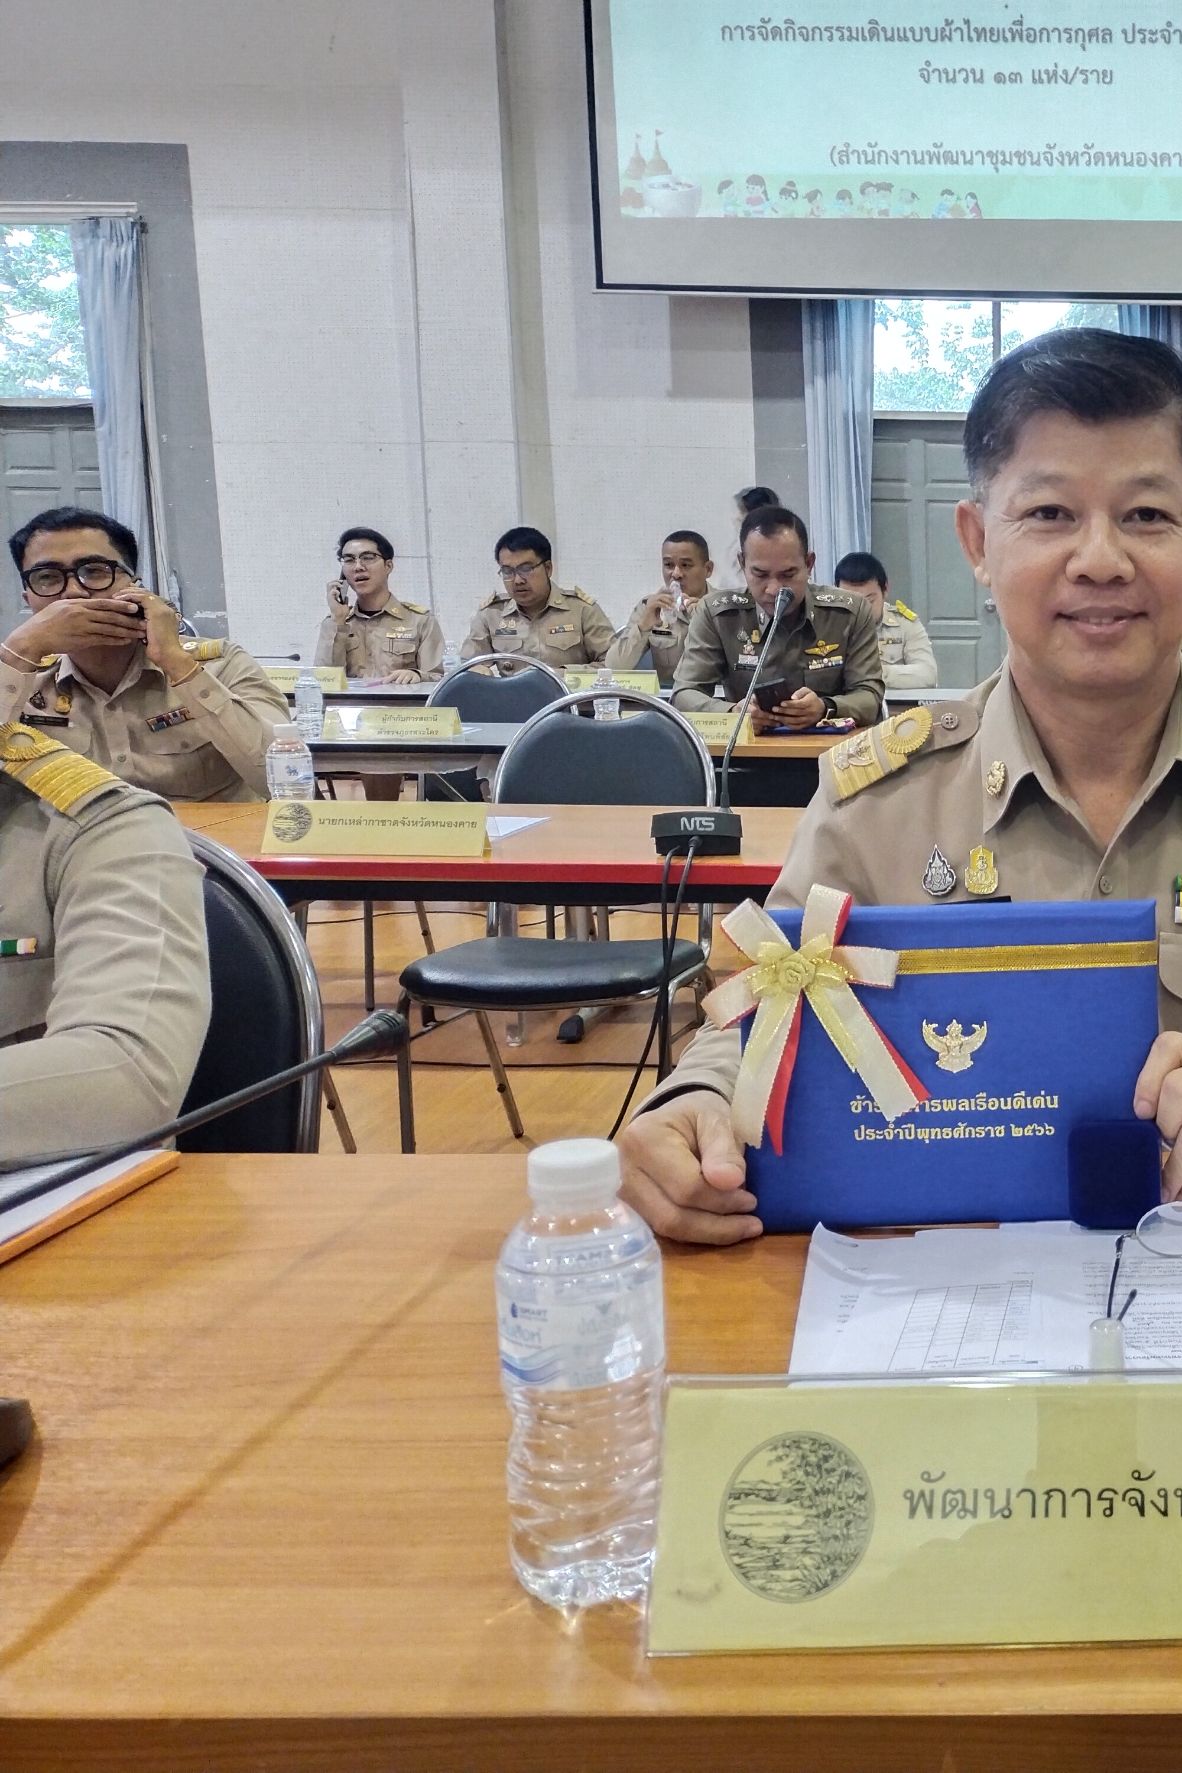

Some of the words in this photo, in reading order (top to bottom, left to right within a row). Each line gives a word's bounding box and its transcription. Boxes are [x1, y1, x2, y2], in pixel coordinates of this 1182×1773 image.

[720, 14, 1113, 51] การจัดกิจกรรมเดินแบบผ้าไทยเพื่อการกุศล
[918, 60, 984, 84] จำนวน
[993, 71, 1023, 85] ๑๓
[1031, 62, 1113, 85] แห่ง/ราย
[318, 816, 477, 829] นายกเหล่ากาชาดจังหวัดหนองคาย
[681, 817, 715, 831] NTS
[854, 1121, 1005, 1143] ประจำปีพุทธศักราช
[1010, 1123, 1055, 1136] ๒๕๖๖
